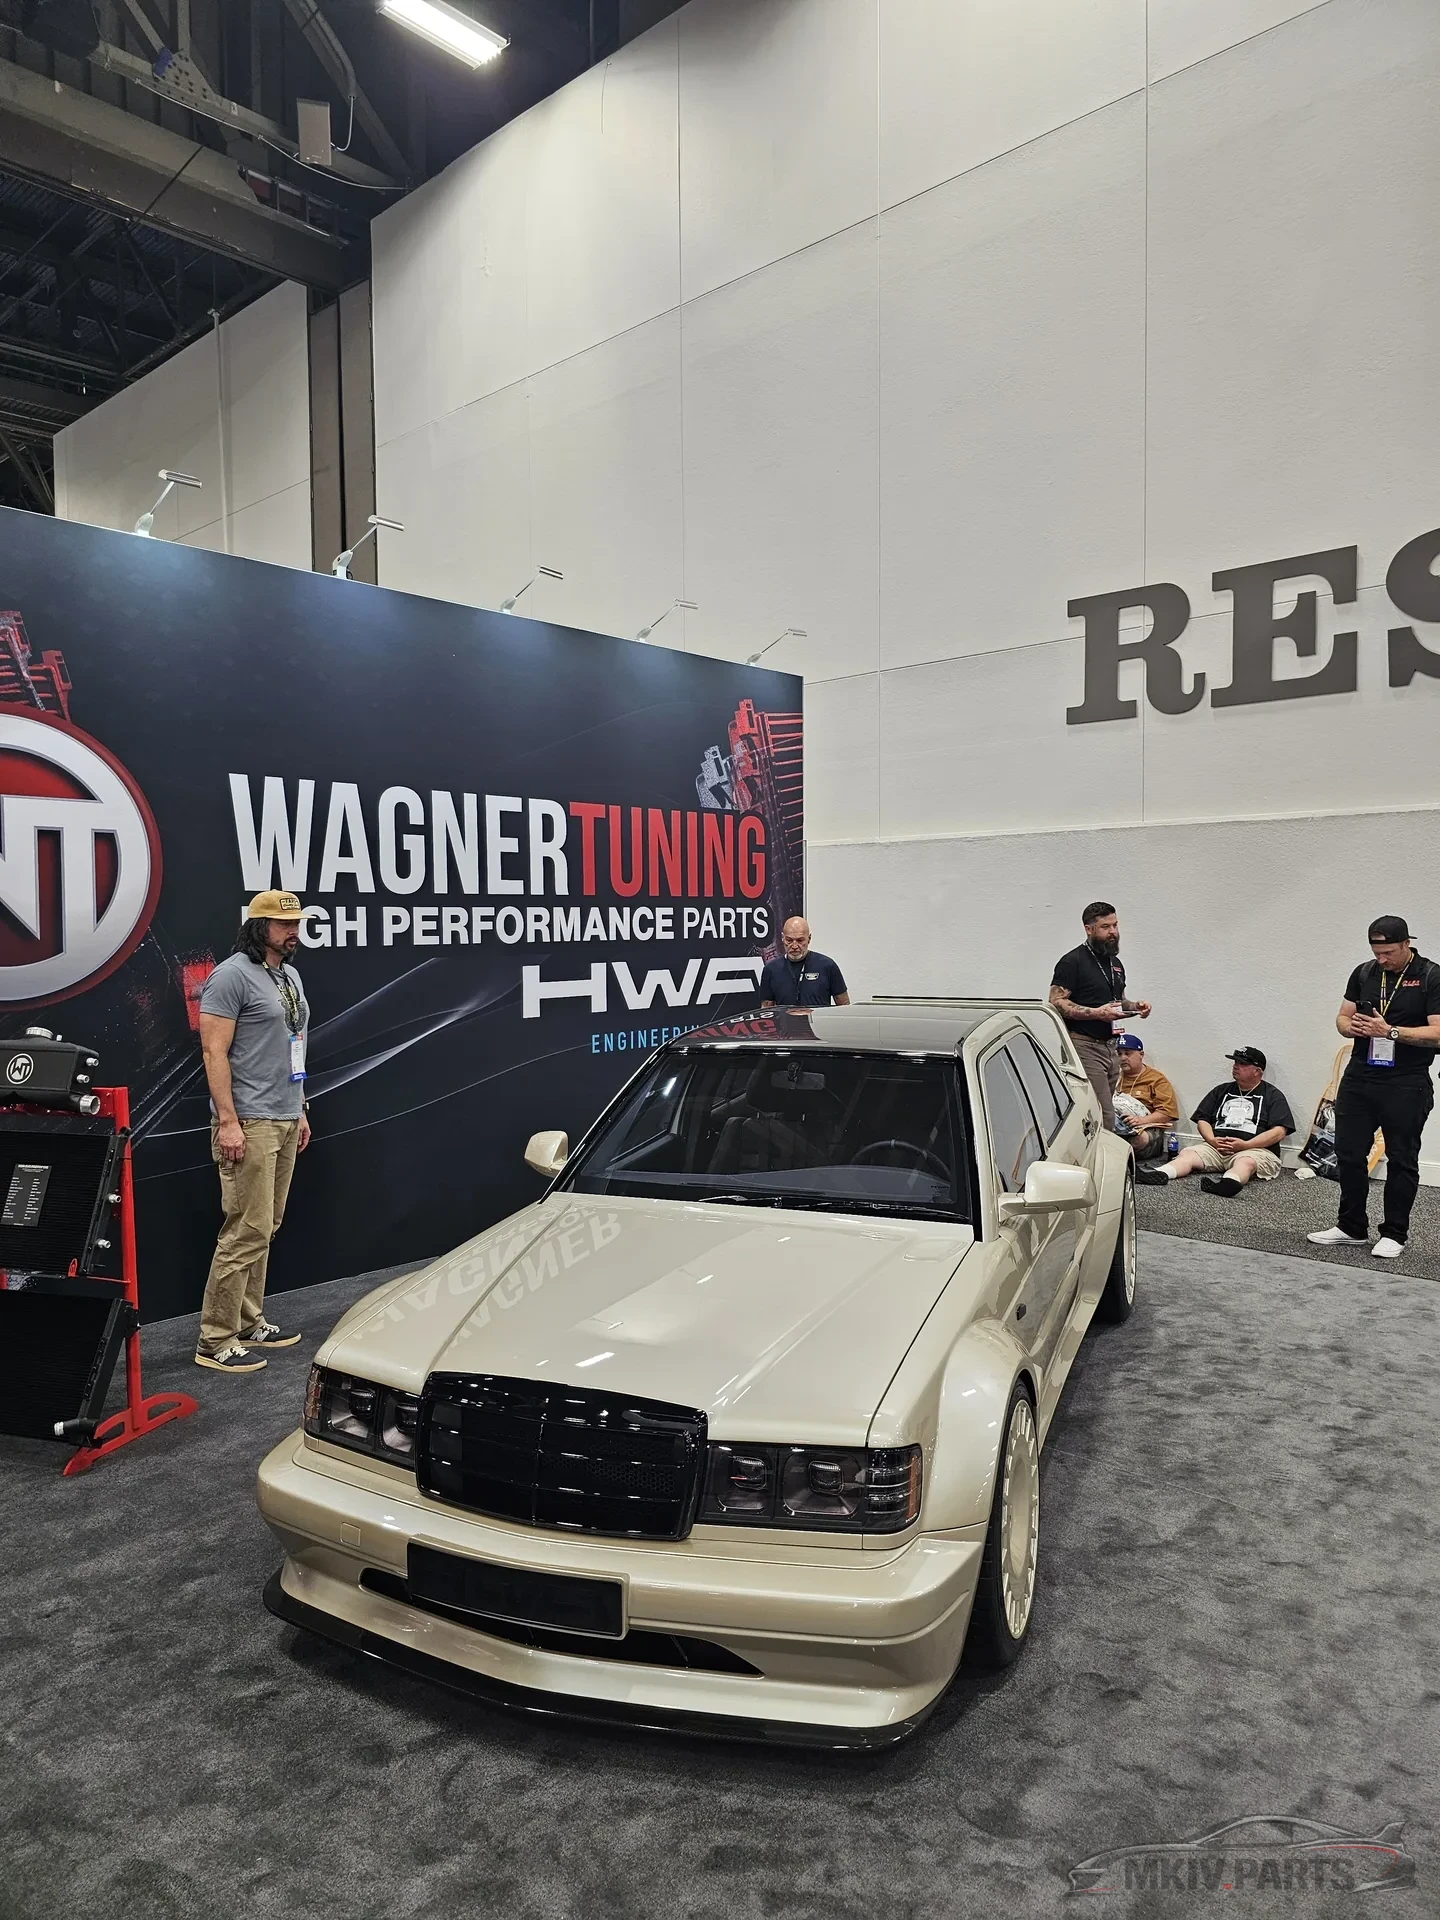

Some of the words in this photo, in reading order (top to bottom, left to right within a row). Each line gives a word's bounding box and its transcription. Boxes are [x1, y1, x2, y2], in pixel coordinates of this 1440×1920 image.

[240, 906, 368, 949] GH
[382, 906, 675, 946] PERFORMANCE
[683, 907, 769, 939] PARTS
